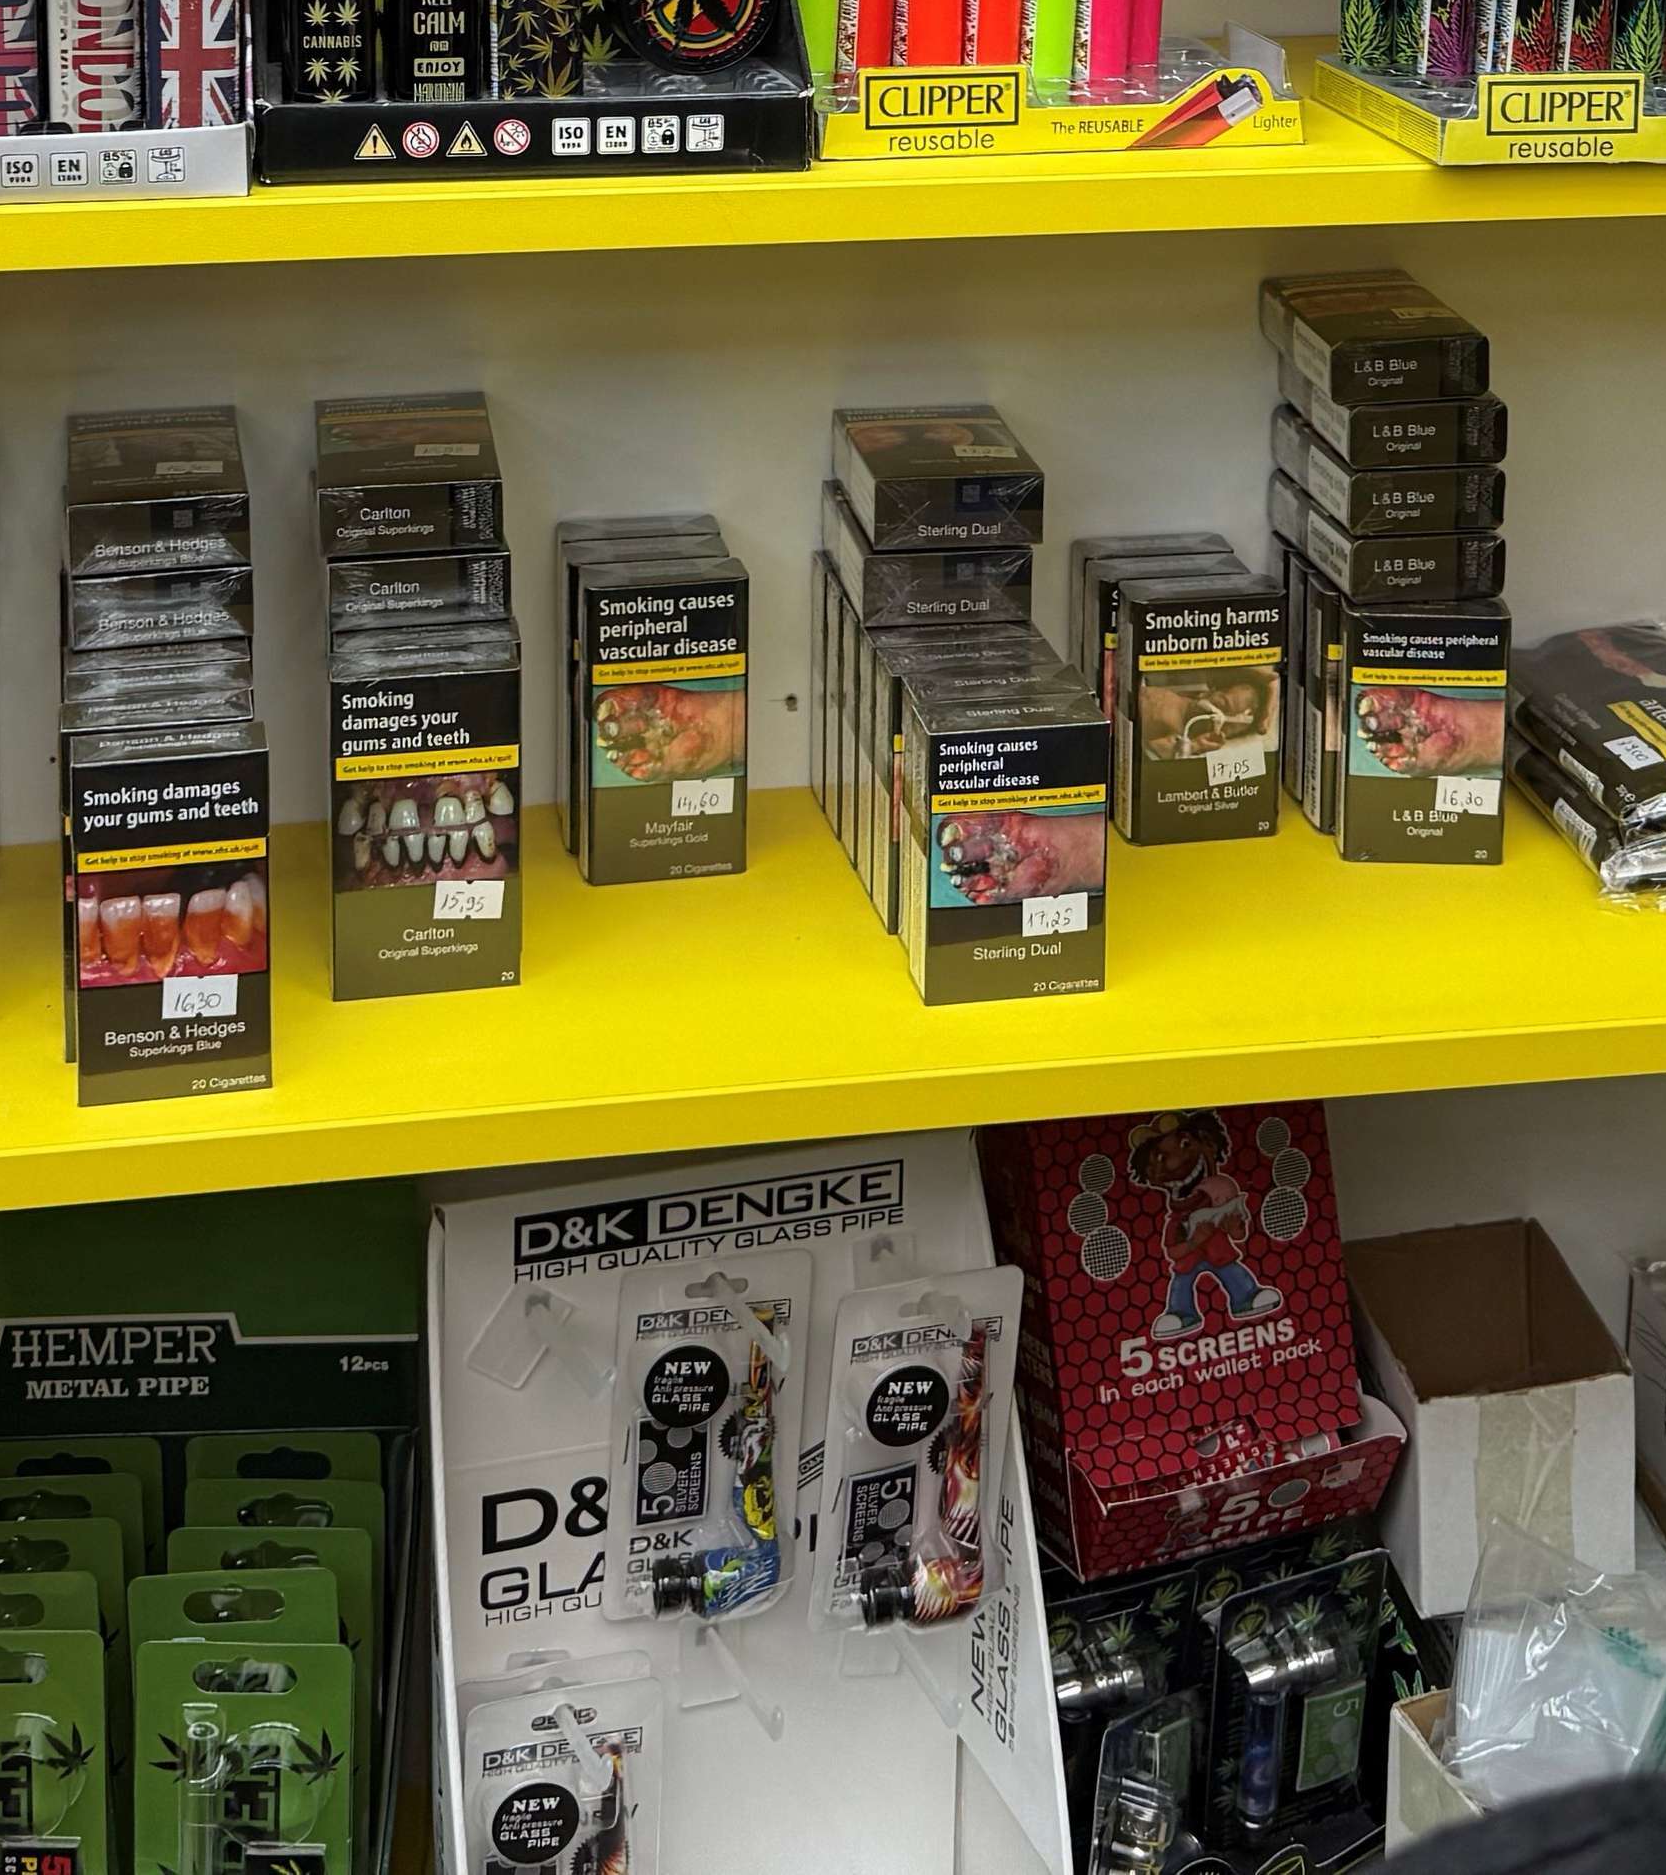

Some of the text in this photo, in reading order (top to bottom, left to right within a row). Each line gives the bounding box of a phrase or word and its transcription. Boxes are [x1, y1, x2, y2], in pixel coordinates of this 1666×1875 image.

[413, 12, 465, 36] CALM
[303, 34, 362, 50] CANNABIS
[417, 60, 461, 74] ENJOY
[877, 86, 1005, 118] CLIPPER
[1500, 90, 1625, 124] CLIPPER
[1051, 115, 1298, 135] The REUSABLE Lighter
[888, 130, 994, 152] reusable
[1508, 137, 1614, 161] reusable
[1354, 358, 1418, 373] L&B Blue
[599, 594, 735, 617] Smoking causes
[599, 616, 688, 642] peripheral
[1145, 607, 1280, 636] Smoking harms
[599, 637, 737, 660] vascular disease
[1145, 630, 1270, 654] unborn babies
[83, 781, 240, 809] Smoking damages
[83, 798, 258, 832] your gums and teeth
[402, 926, 455, 942] Carlton
[973, 942, 1062, 961] Sterling Dual
[104, 1021, 245, 1046] Benson & Hedges
[518, 1169, 894, 1259] D&K DENGKE
[515, 1207, 904, 1283] HIGH QUALITY GLASS PIPE
[11, 1325, 218, 1369] HEMPER
[1119, 1318, 1296, 1379] 5 SCREENS
[664, 1360, 711, 1377] NEW
[1099, 1338, 1322, 1405] In each wallet pack
[26, 1376, 210, 1400] METAL PIPE
